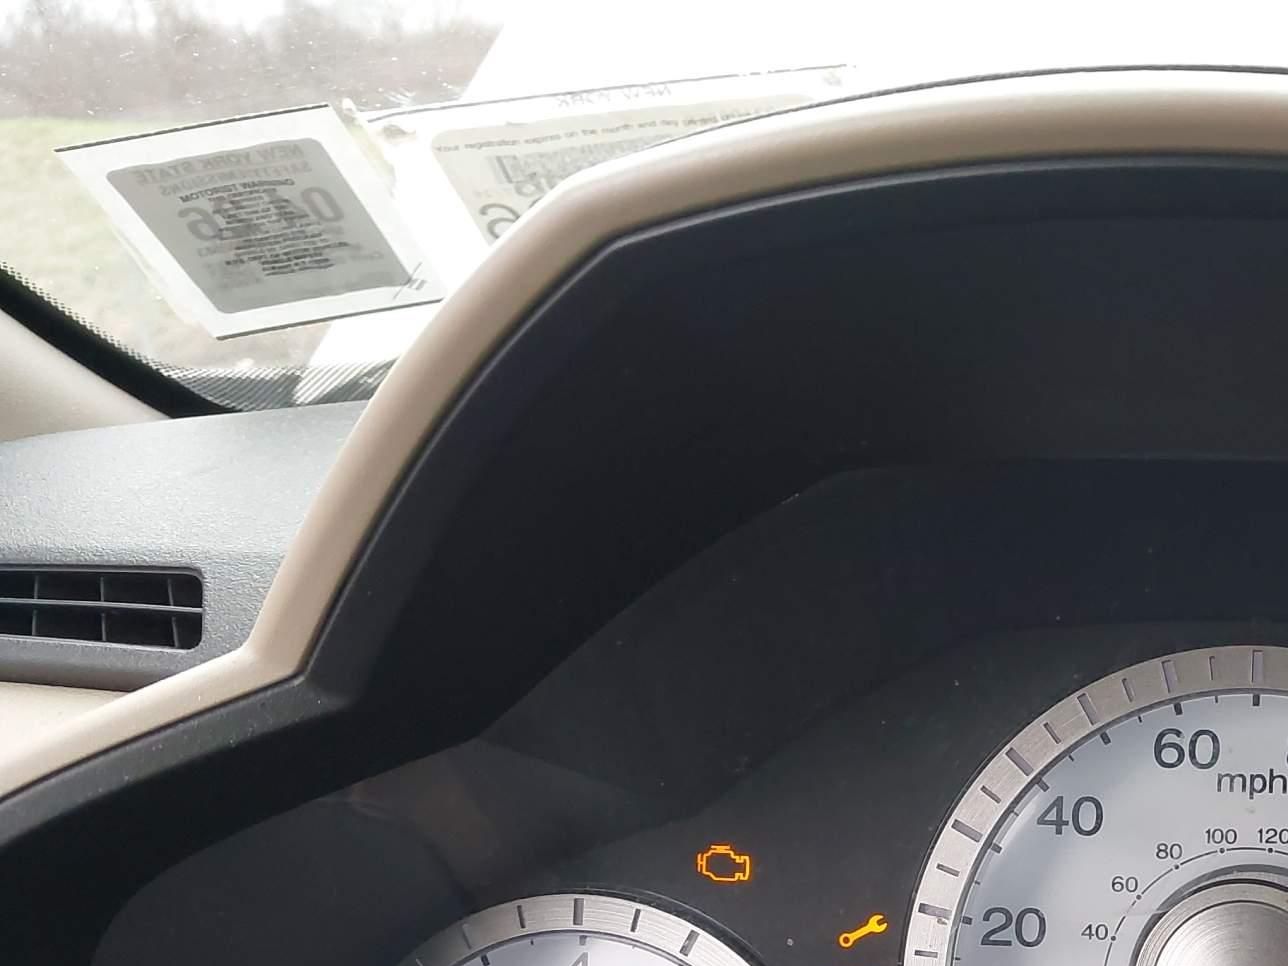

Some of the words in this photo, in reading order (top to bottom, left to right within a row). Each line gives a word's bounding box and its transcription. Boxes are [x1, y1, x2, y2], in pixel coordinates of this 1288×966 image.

[179, 182, 239, 203] MOTORIST
[1154, 729, 1220, 770] 60
[1217, 770, 1288, 799] mph
[1037, 796, 1103, 836] 40
[1206, 829, 1237, 844] 100
[1156, 844, 1183, 860] 80
[1111, 876, 1138, 892] 60
[981, 907, 1047, 947] 20
[1081, 924, 1108, 940] 40
